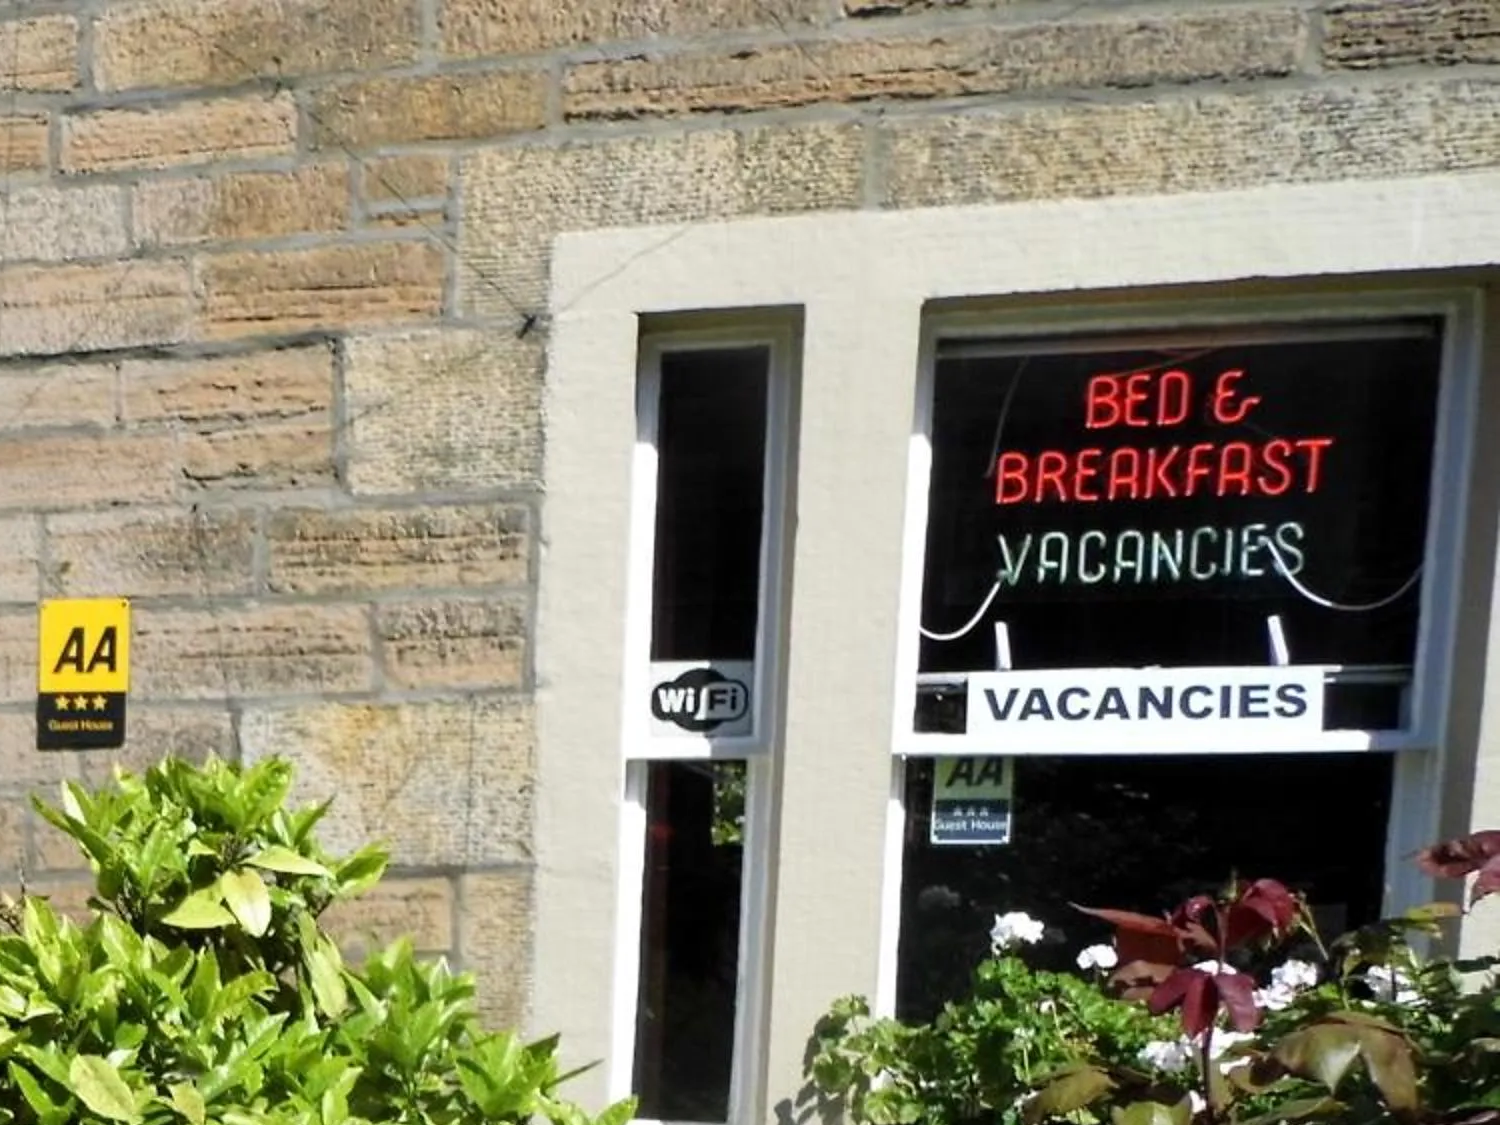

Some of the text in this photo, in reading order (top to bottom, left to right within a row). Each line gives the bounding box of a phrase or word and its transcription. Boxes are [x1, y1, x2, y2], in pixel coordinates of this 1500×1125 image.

[1085, 370, 1261, 428] BED &
[996, 438, 1333, 504] BREAKFAST
[997, 521, 1304, 586] VACANCIES
[52, 625, 117, 674] AA
[983, 682, 1308, 721] VACANCIES
[945, 755, 1003, 788] AA
[934, 818, 967, 831] Guest
